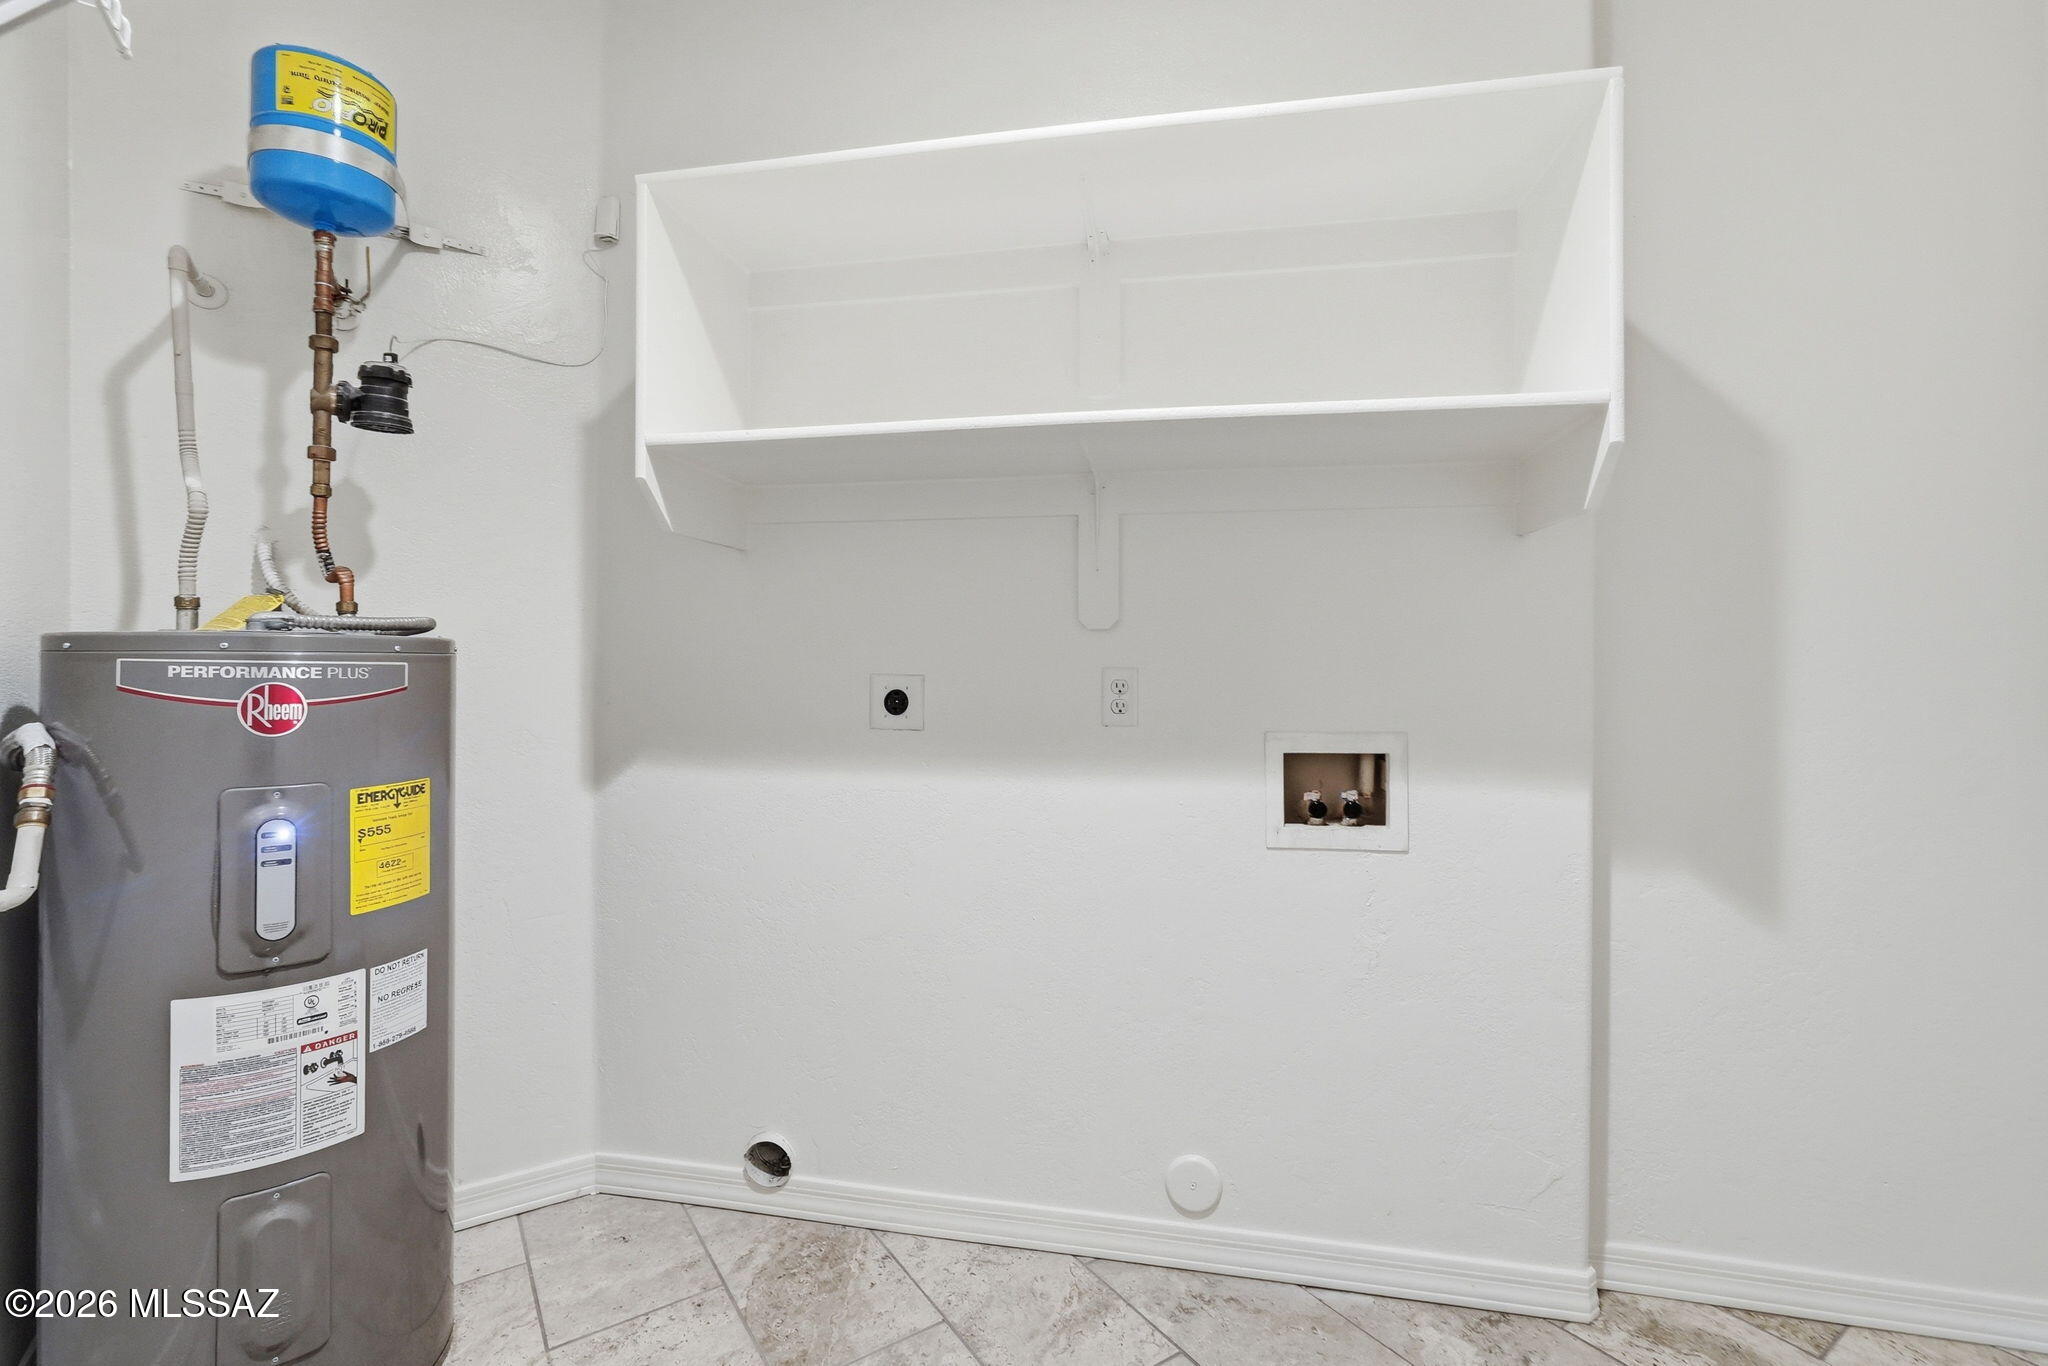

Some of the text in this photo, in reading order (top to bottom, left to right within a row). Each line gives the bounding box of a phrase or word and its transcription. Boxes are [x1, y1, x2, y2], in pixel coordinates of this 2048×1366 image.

[167, 665, 322, 679] PERFORMANCE
[246, 685, 301, 727] Rheem
[358, 824, 392, 839] $555
[374, 966, 386, 976] DO
[387, 961, 400, 971] NOT
[377, 993, 390, 1003] NO
[314, 1033, 356, 1050] DANGER
